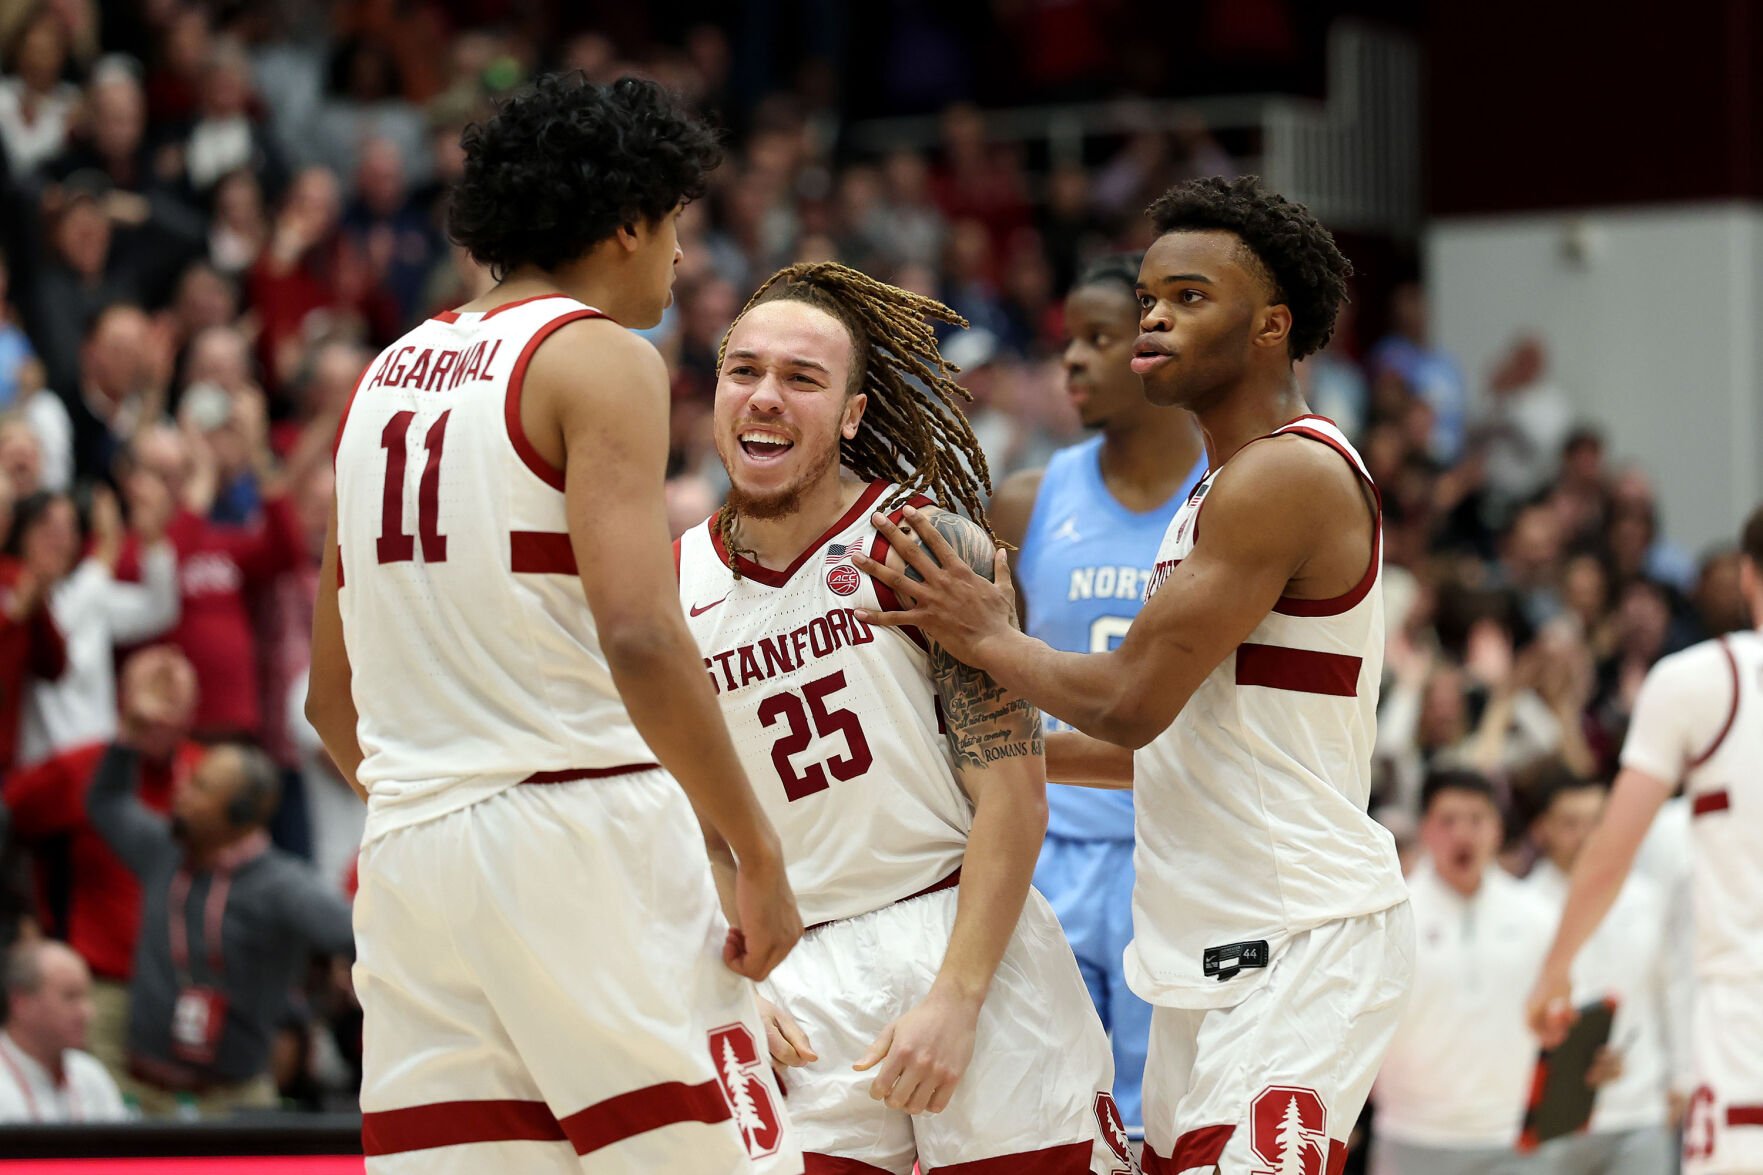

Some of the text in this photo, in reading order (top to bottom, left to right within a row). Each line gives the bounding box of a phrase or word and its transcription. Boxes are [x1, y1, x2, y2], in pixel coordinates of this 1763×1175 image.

[367, 339, 502, 392] AGARWAL
[376, 408, 452, 565] 11
[832, 574, 857, 582] ACC
[1069, 565, 1152, 603] NORT
[757, 669, 873, 802] 25
[984, 742, 1028, 762] ROMANS
[1243, 948, 1257, 959] 44
